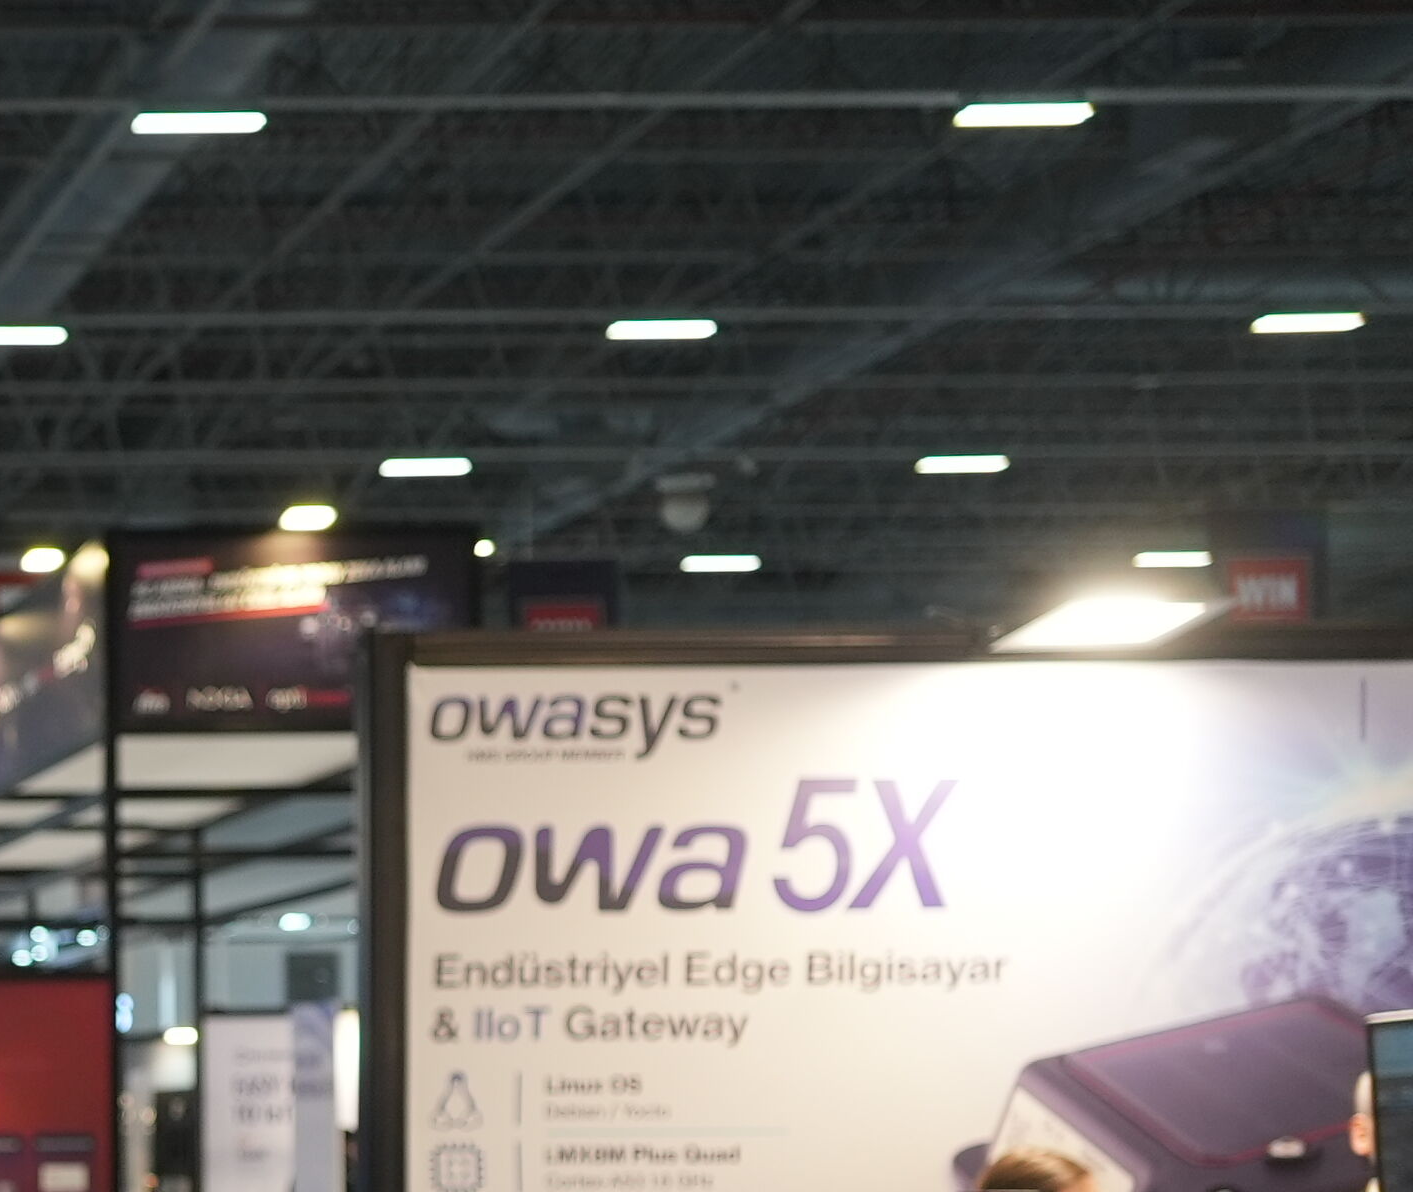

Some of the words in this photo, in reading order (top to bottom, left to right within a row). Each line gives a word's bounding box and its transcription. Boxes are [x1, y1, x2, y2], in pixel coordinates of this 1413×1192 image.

[429, 692, 724, 761] owasys
[435, 822, 750, 914] owa
[773, 777, 960, 913] 5X
[433, 950, 672, 994] Endüstriyel
[685, 951, 792, 994] Edge
[805, 949, 1009, 995] Bilgisayar
[431, 1006, 459, 1043] &
[563, 1007, 750, 1047] Gateway
